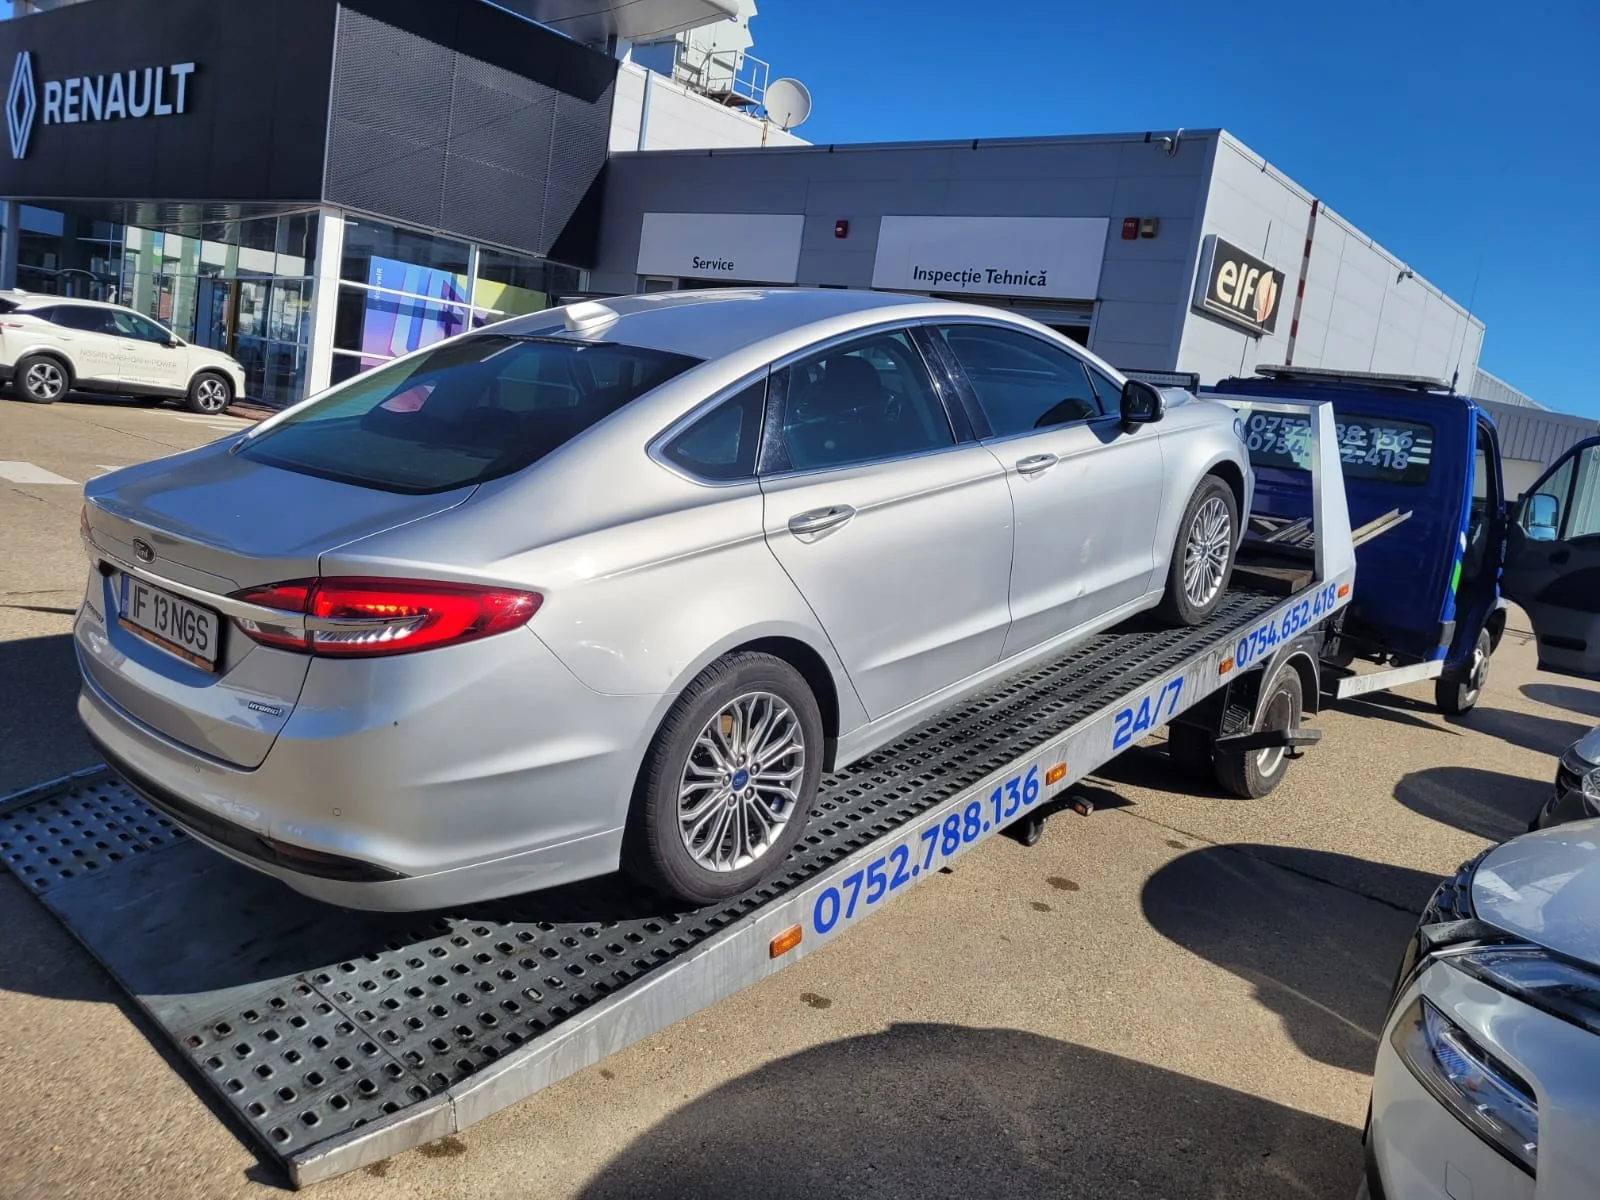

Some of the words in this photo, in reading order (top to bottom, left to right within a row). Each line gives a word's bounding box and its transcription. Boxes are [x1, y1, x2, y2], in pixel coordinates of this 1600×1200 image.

[43, 62, 195, 125] RENAULT
[692, 256, 734, 271] Service
[913, 265, 982, 288] Inspecție
[985, 268, 1047, 287] Tehnică
[1216, 260, 1259, 310] elf
[133, 584, 149, 619] IF
[154, 594, 168, 632] 13
[171, 602, 209, 651] NGS
[1236, 582, 1336, 668] 0754.652.418
[1112, 676, 1184, 751] 24/7
[813, 764, 1039, 934] 0752.788.136
